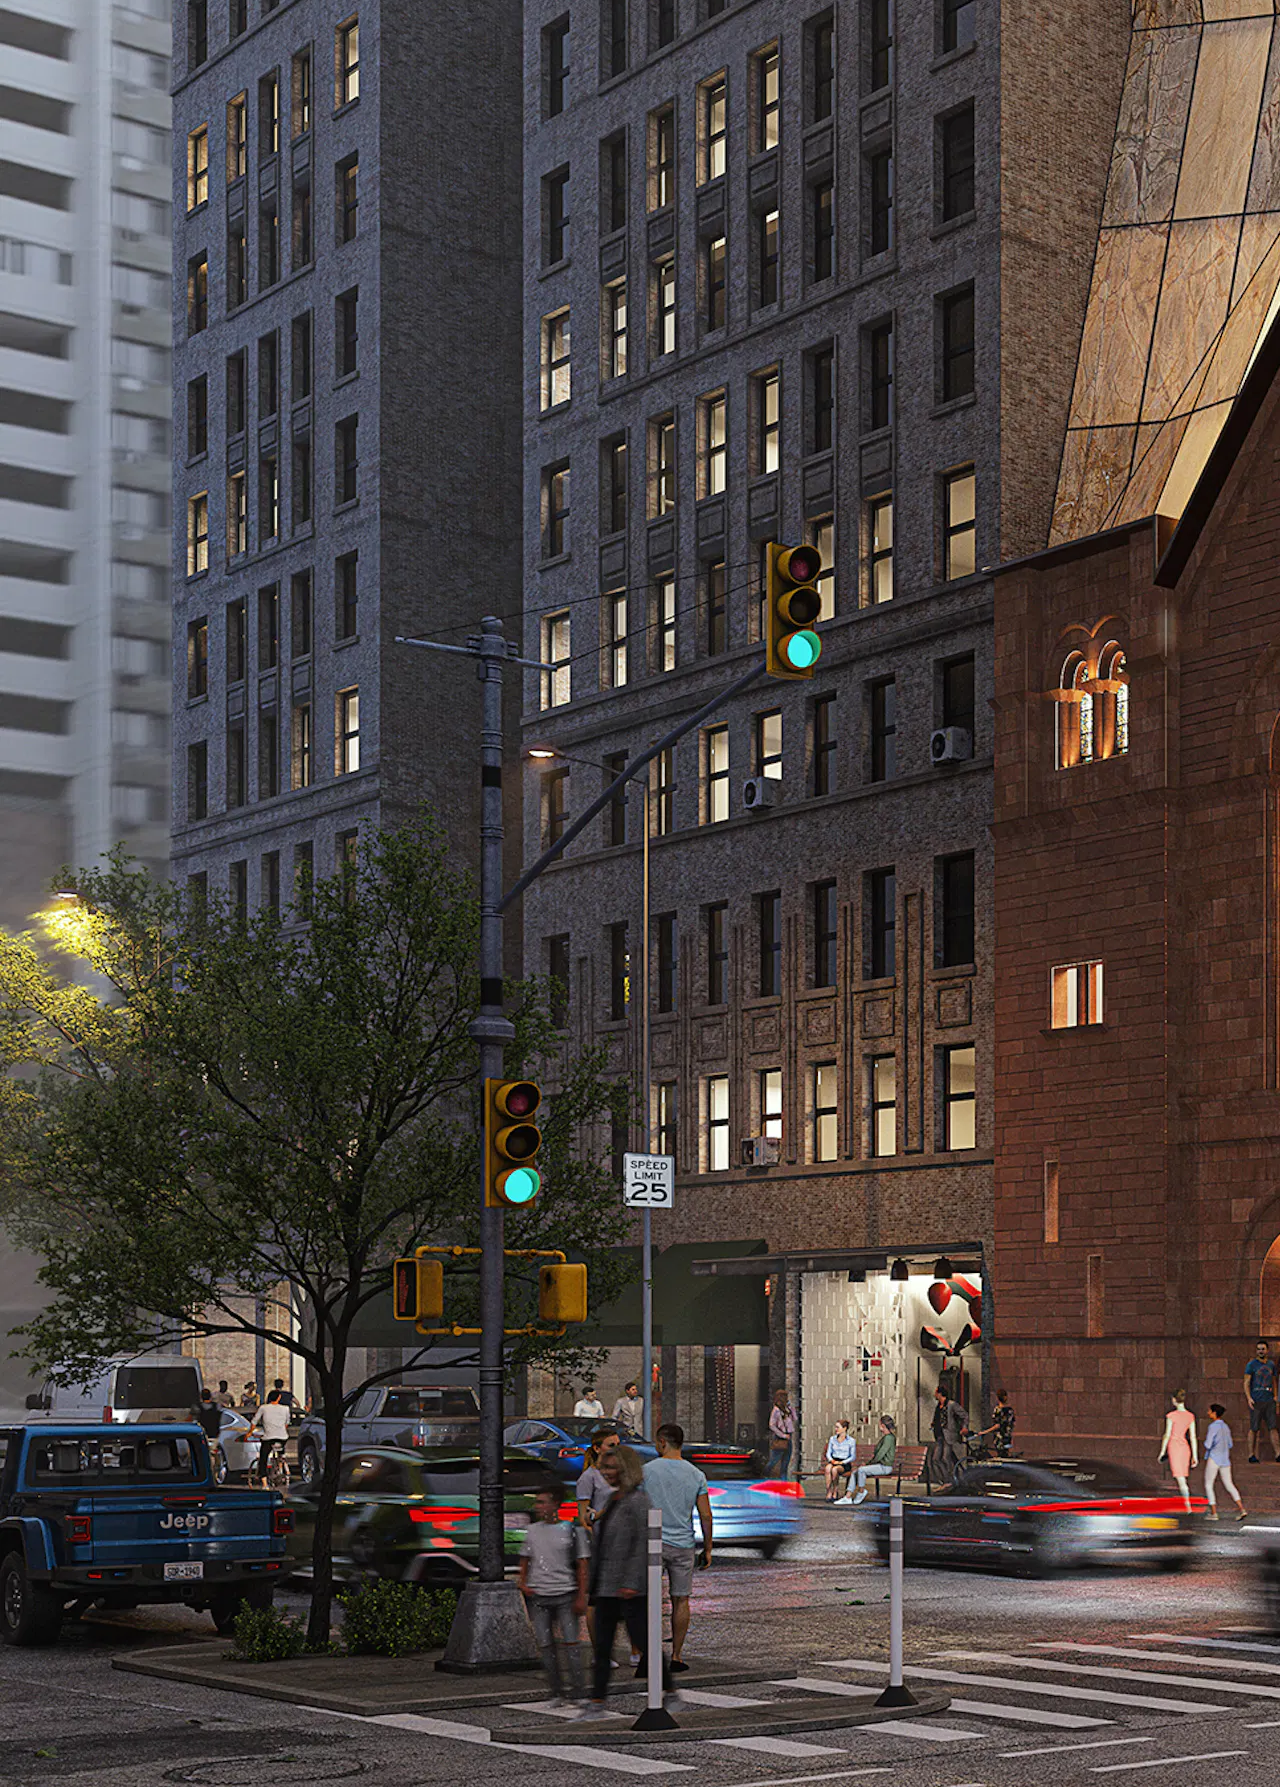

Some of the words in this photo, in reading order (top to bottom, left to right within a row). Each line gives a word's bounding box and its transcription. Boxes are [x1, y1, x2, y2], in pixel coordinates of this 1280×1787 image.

[630, 1160, 668, 1170] SPEED
[634, 1172, 663, 1180] LIMIT
[630, 1182, 668, 1202] 25
[160, 1513, 209, 1530] Jeep
